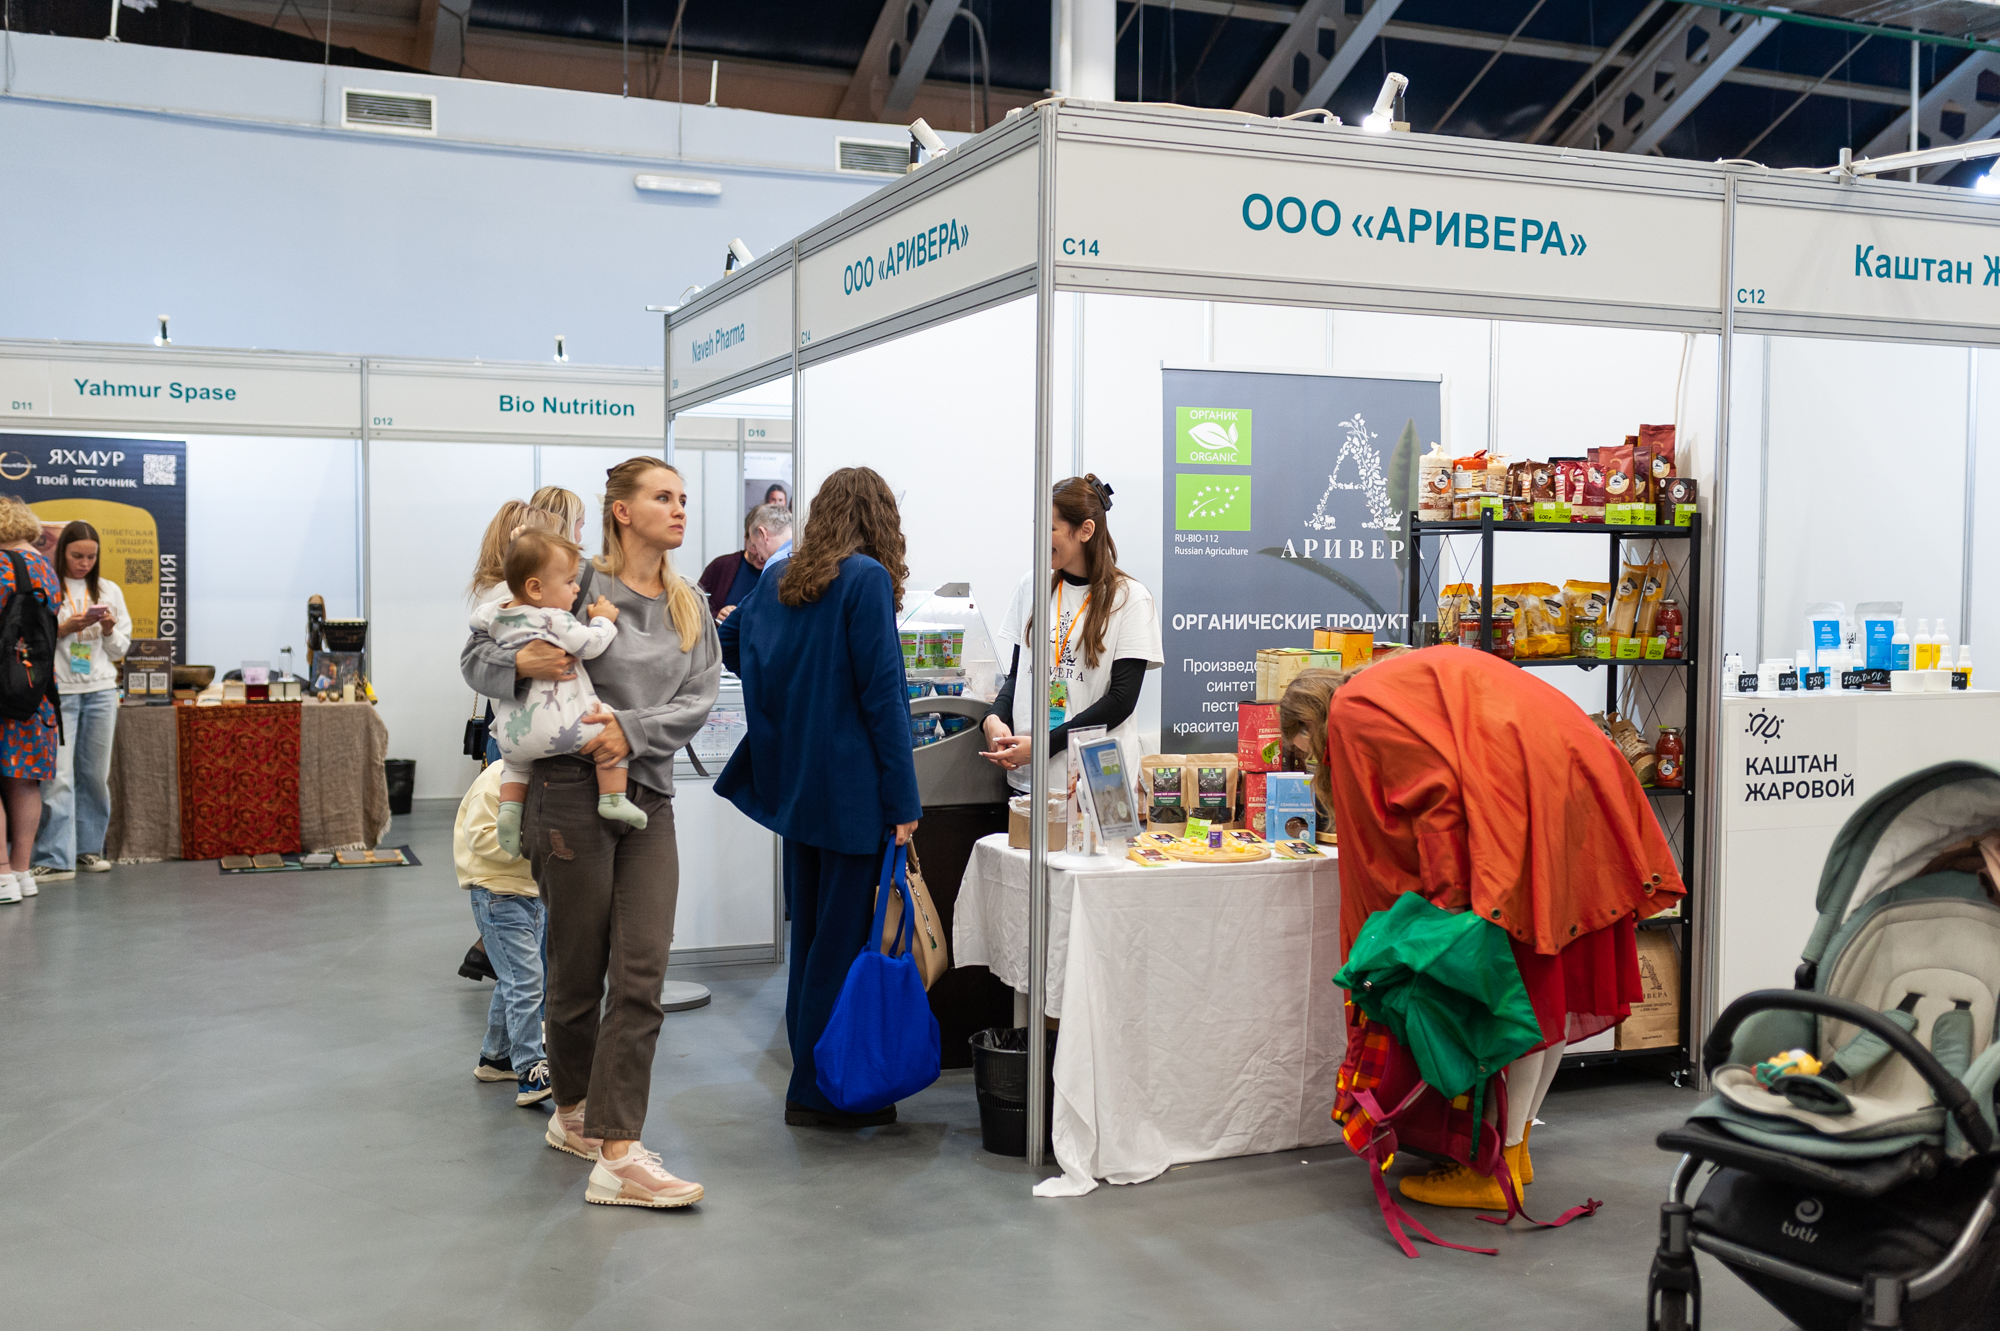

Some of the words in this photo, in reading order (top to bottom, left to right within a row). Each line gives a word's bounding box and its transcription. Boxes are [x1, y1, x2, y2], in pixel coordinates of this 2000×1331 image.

[1242, 193, 1341, 237] ООО
[1351, 206, 1588, 257] «АРИВЕРА»
[844, 256, 874, 296] ООО
[878, 218, 969, 281] «АРИВЕРА»
[1855, 244, 1972, 285] Каштан
[692, 331, 713, 364] Naveh
[715, 323, 745, 353] Pharma
[73, 379, 162, 398] Yahmur
[169, 382, 237, 403] Spase
[12, 401, 33, 411] D11
[499, 395, 535, 413] Bio
[543, 396, 635, 417] Nutrition
[373, 417, 393, 426] D12
[1190, 410, 1239, 421] ОРГАНИК
[748, 429, 766, 437] D10
[48, 449, 125, 467] ЯХМУР
[1190, 451, 1238, 463] ORGANIC
[34, 475, 69, 486] ТВОЙ
[72, 476, 138, 489] ИСТОЧНИК
[1174, 534, 1219, 543] RU-BIO-112
[1174, 546, 1203, 556] Russian
[1204, 547, 1249, 558] Agriculture
[1172, 614, 1321, 631] ОРГАНИЧЕСКИЕ
[1183, 659, 1258, 673] Произведе
[1206, 680, 1256, 692] синтет
[1173, 721, 1239, 734] красител
[1746, 754, 1837, 776] КАШТАН
[1745, 773, 1854, 802] ЖАРОВОЙ
[1781, 1220, 1819, 1244] tutis
